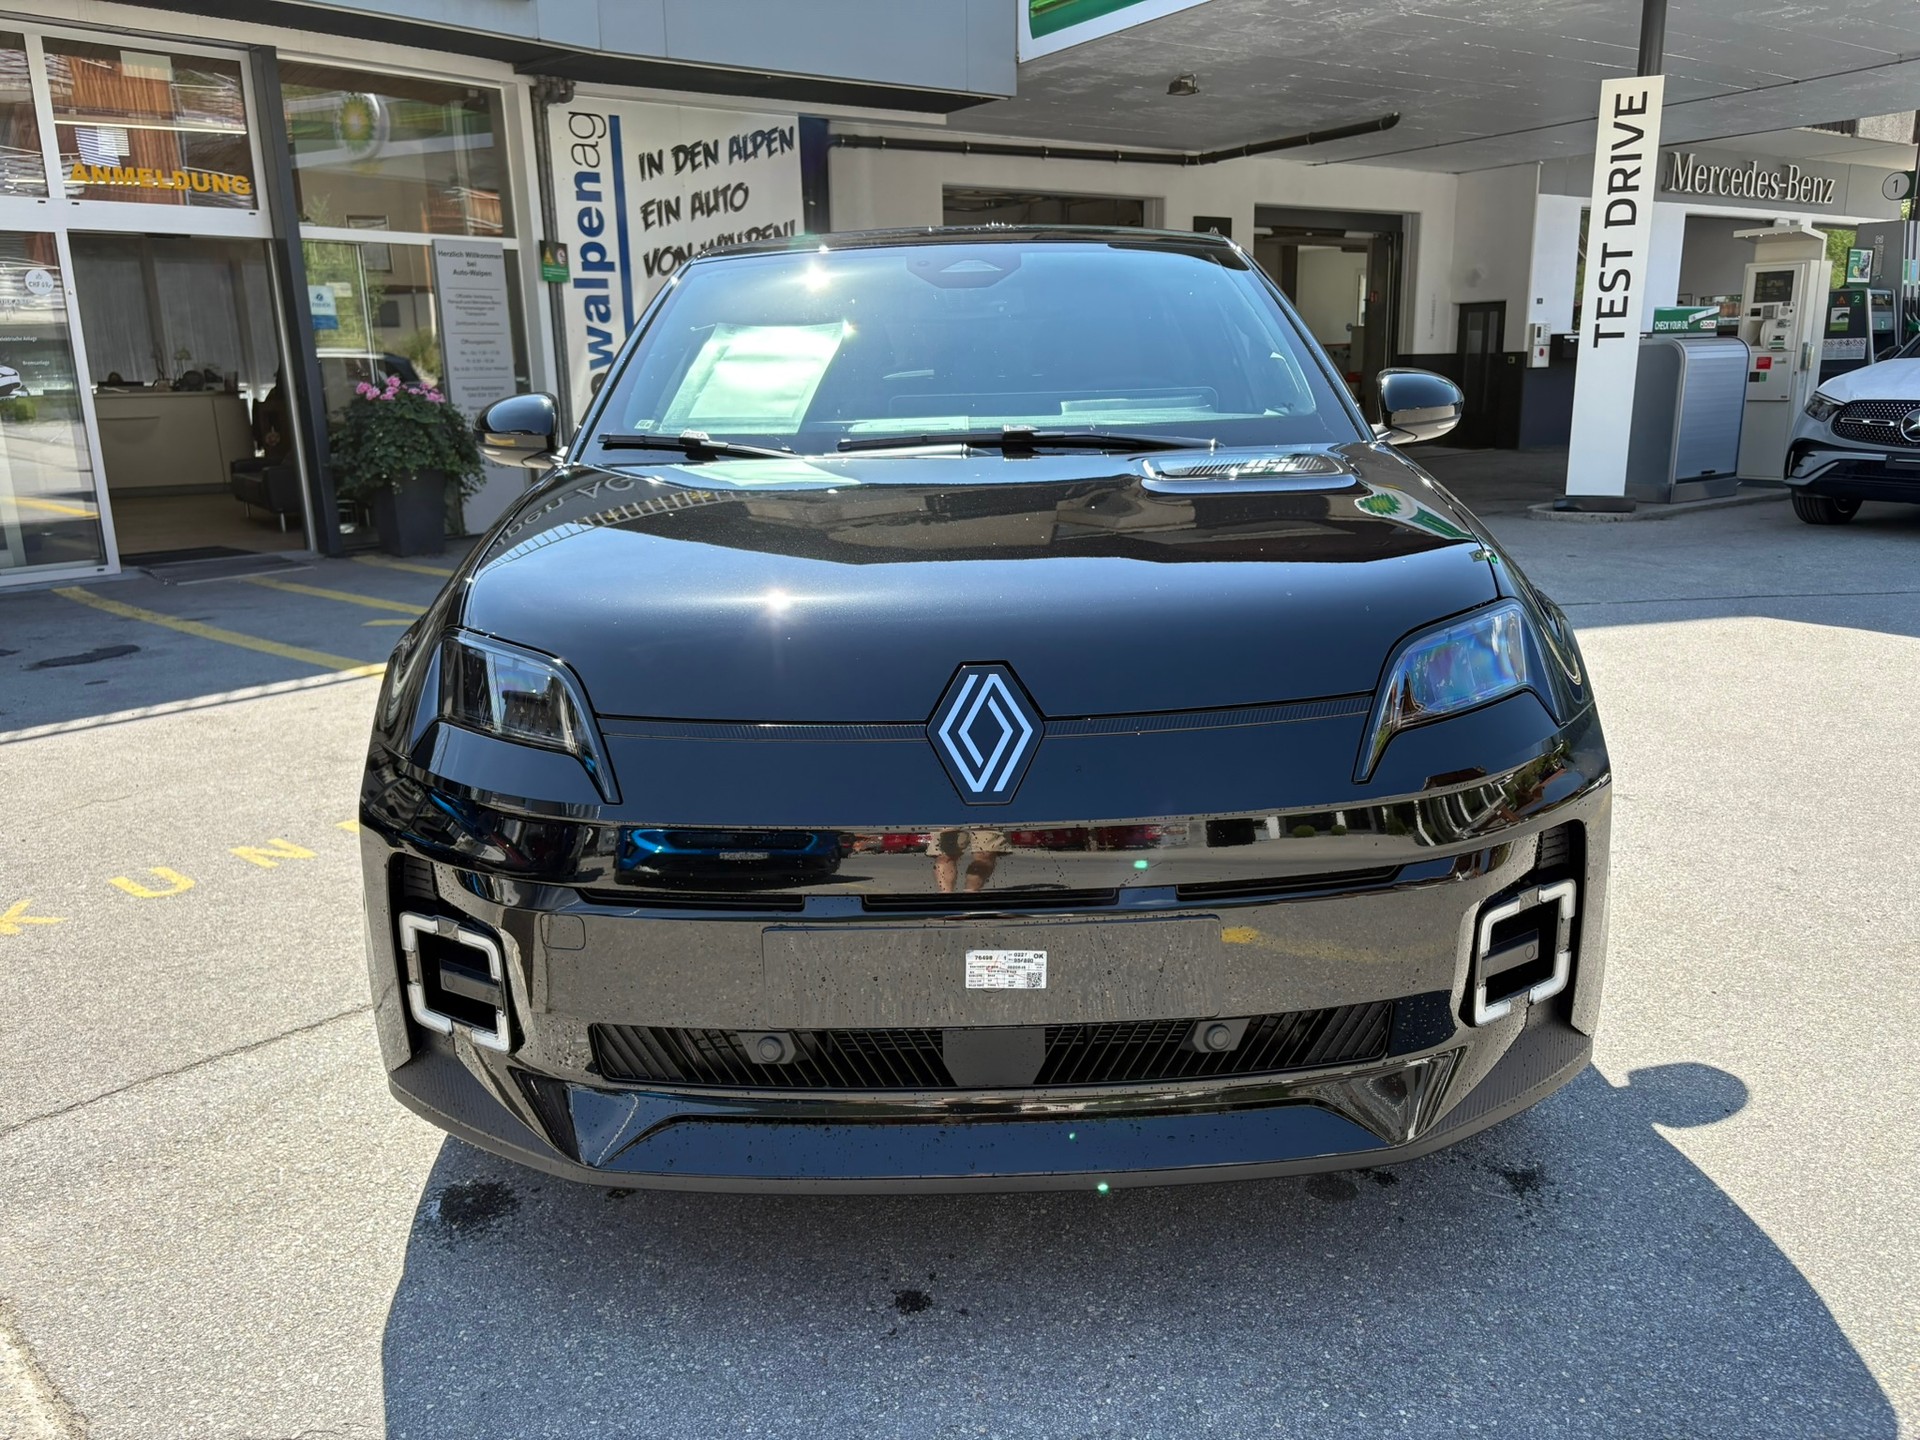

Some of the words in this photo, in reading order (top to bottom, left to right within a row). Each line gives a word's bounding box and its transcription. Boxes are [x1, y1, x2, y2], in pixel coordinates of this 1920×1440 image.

[70, 162, 252, 194] ANMELDUNG
[638, 149, 664, 182] IN
[671, 139, 720, 176] DEN
[728, 125, 794, 166] ALPEN
[1604, 91, 1648, 229] DRIVE
[1668, 151, 1836, 205] Mercedes-Benz
[640, 196, 681, 232] EIN
[691, 182, 750, 222] AUTO
[643, 243, 693, 278] VON
[1593, 242, 1633, 348] TEST
[1854, 295, 1860, 303] 2
